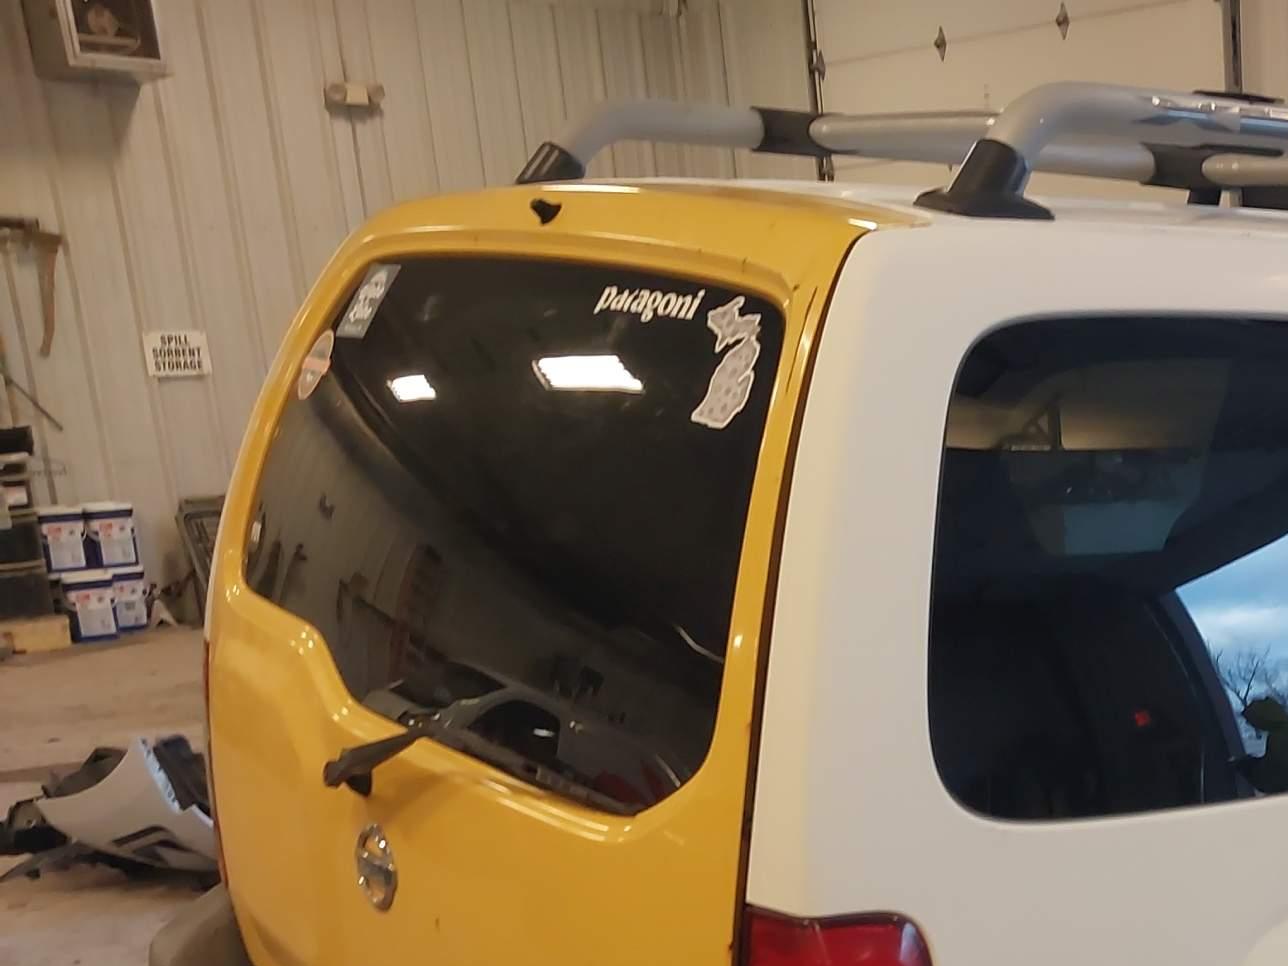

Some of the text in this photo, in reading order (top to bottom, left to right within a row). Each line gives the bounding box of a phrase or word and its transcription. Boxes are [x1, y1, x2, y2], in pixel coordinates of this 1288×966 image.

[593, 285, 706, 323] paragoni
[160, 334, 190, 346] SPILL
[152, 347, 202, 359] SORBENT
[154, 360, 203, 373] STORAGE
